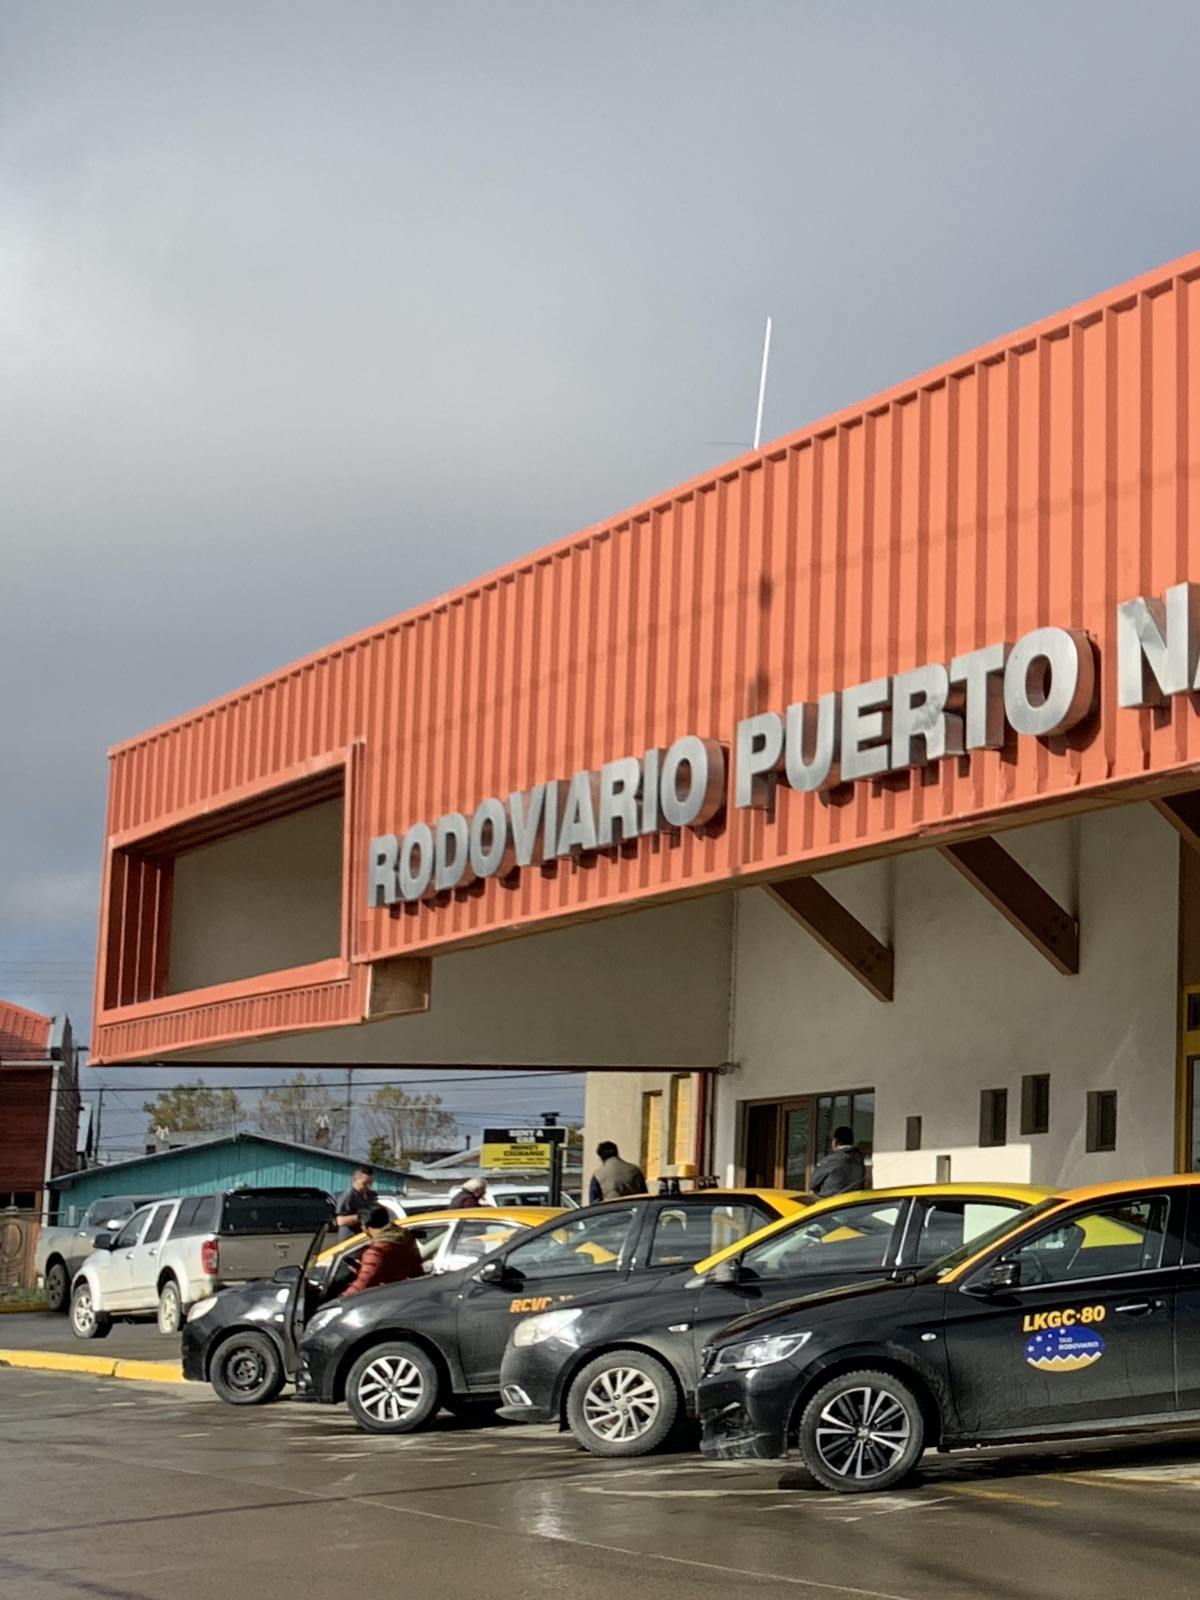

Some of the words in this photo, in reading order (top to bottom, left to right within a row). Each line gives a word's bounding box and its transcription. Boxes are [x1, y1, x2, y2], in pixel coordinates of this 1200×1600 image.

[367, 734, 722, 907] RODOVIARIO
[735, 626, 1090, 810] PUERTO
[1058, 1341, 1099, 1351] RODOVIARIO
